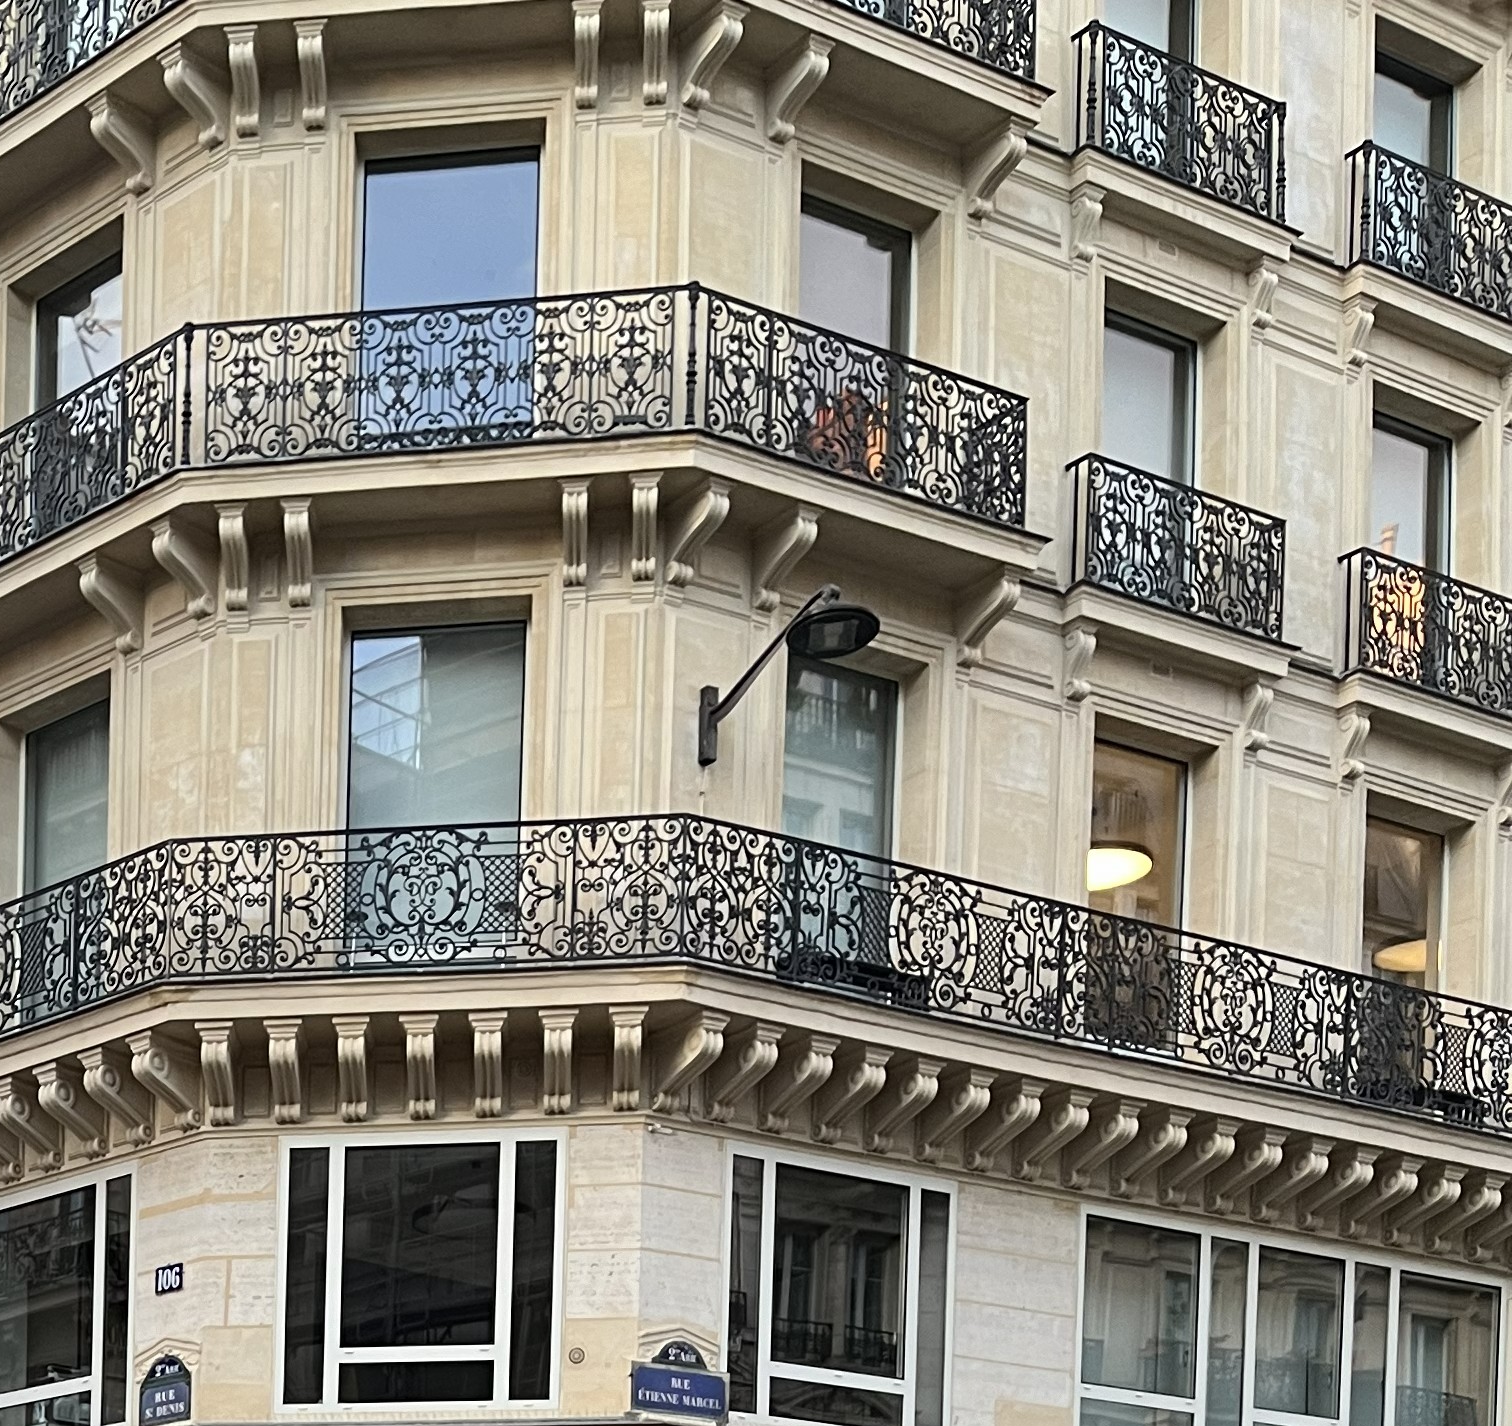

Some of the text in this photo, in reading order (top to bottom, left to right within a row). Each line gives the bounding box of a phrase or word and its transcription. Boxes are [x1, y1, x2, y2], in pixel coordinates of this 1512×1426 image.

[671, 1378, 690, 1390] RUE
[155, 1389, 175, 1403] RUE
[638, 1387, 722, 1409] ÉTIENNE MARCEL
[156, 1402, 185, 1418] DENIS
